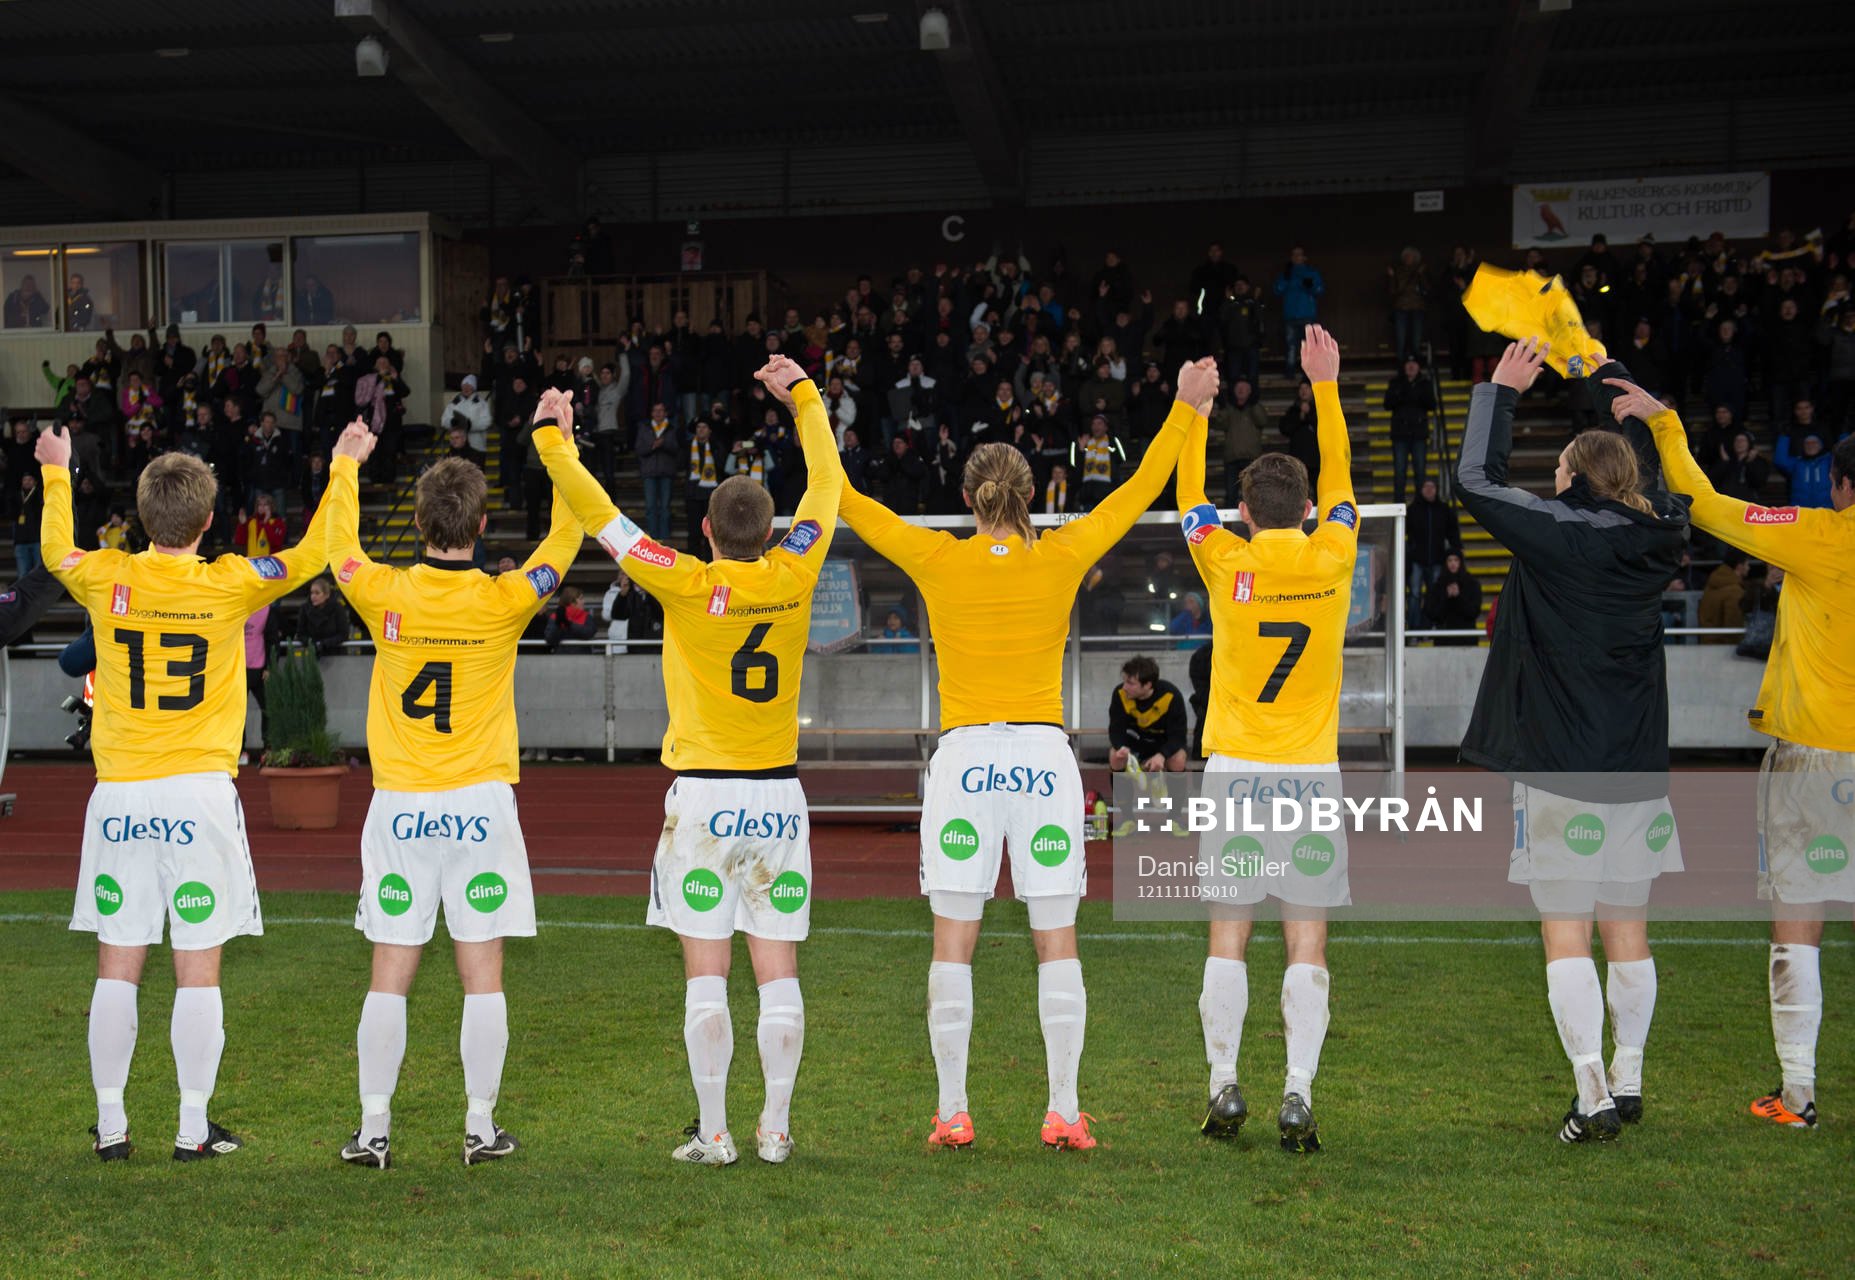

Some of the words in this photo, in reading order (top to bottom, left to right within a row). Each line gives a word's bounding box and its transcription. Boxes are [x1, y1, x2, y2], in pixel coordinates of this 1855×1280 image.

[1577, 182, 1682, 201] FALKENBERGS
[1577, 202, 1645, 220] KULTUR
[1649, 200, 1690, 217] OCH
[1695, 197, 1752, 215] FRITID
[941, 215, 965, 241] C
[1749, 511, 1794, 522] Adecco
[631, 544, 672, 565] Adecco
[1252, 588, 1336, 604] bygghemma.se
[129, 607, 214, 620] bygghemma.se
[726, 601, 799, 617] bygghemma.se
[400, 634, 486, 646] bygghemma.se
[114, 627, 209, 710] 13
[731, 622, 778, 703] 6
[1256, 621, 1311, 703] 7
[401, 661, 452, 733] 4
[961, 763, 1057, 797] GleSYS
[102, 815, 196, 845] GleSYS
[392, 811, 490, 842] GleSYS
[709, 808, 801, 840] GleSYS
[1648, 824, 1671, 841] dina
[943, 830, 976, 846] dina
[1567, 825, 1602, 841] dina
[1033, 838, 1067, 852] dina
[1808, 846, 1846, 861] dina
[1295, 844, 1331, 864] dina
[95, 884, 120, 903] dina
[380, 885, 409, 901] dina
[469, 883, 504, 900] dina
[685, 880, 719, 897] dina
[773, 884, 804, 898] dina
[176, 893, 213, 909] dina
